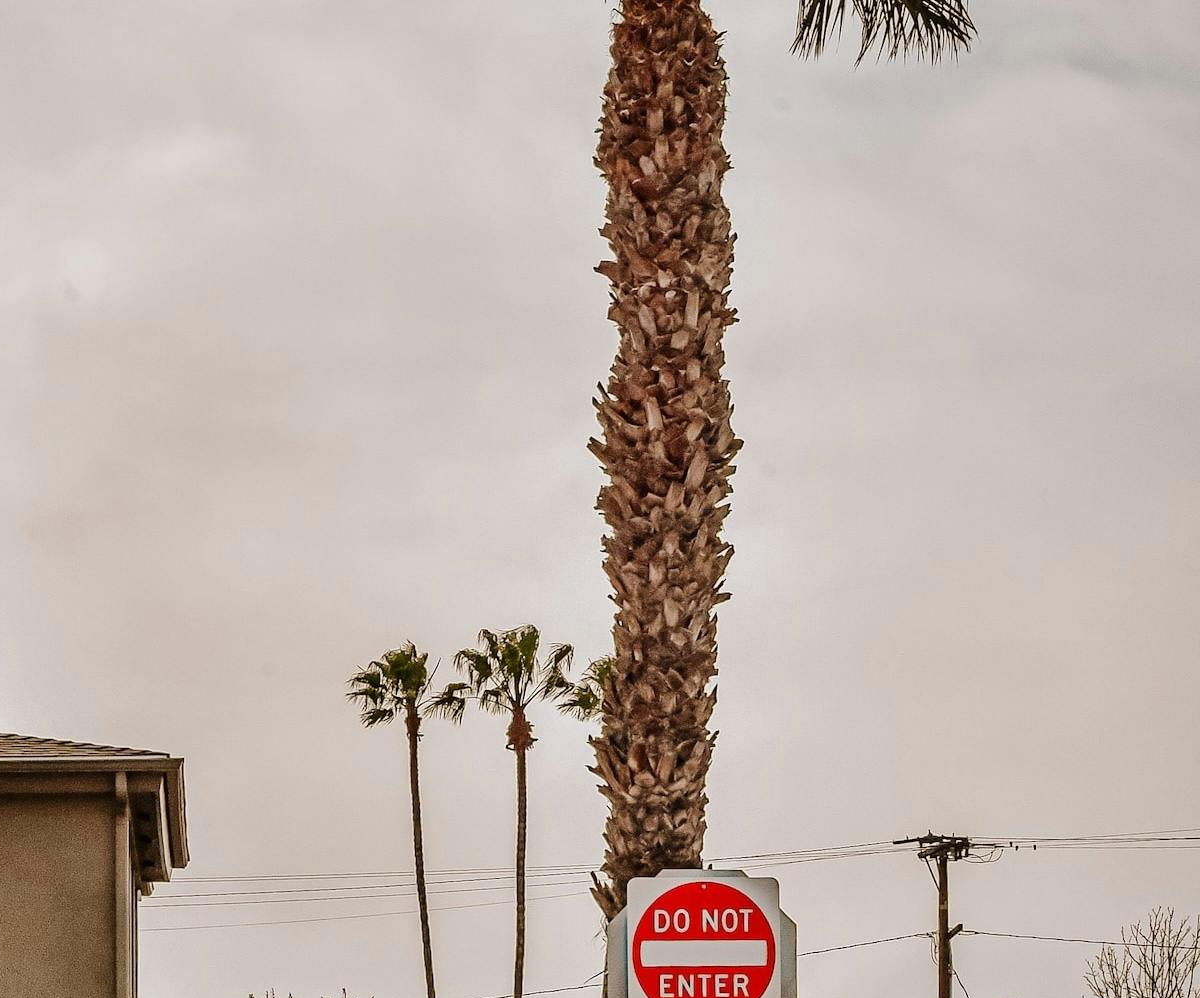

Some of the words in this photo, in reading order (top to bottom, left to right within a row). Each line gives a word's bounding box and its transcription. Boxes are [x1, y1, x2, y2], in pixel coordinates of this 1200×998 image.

[654, 909, 690, 933] DO
[702, 908, 753, 933] NOT
[659, 974, 749, 998] ENTER
